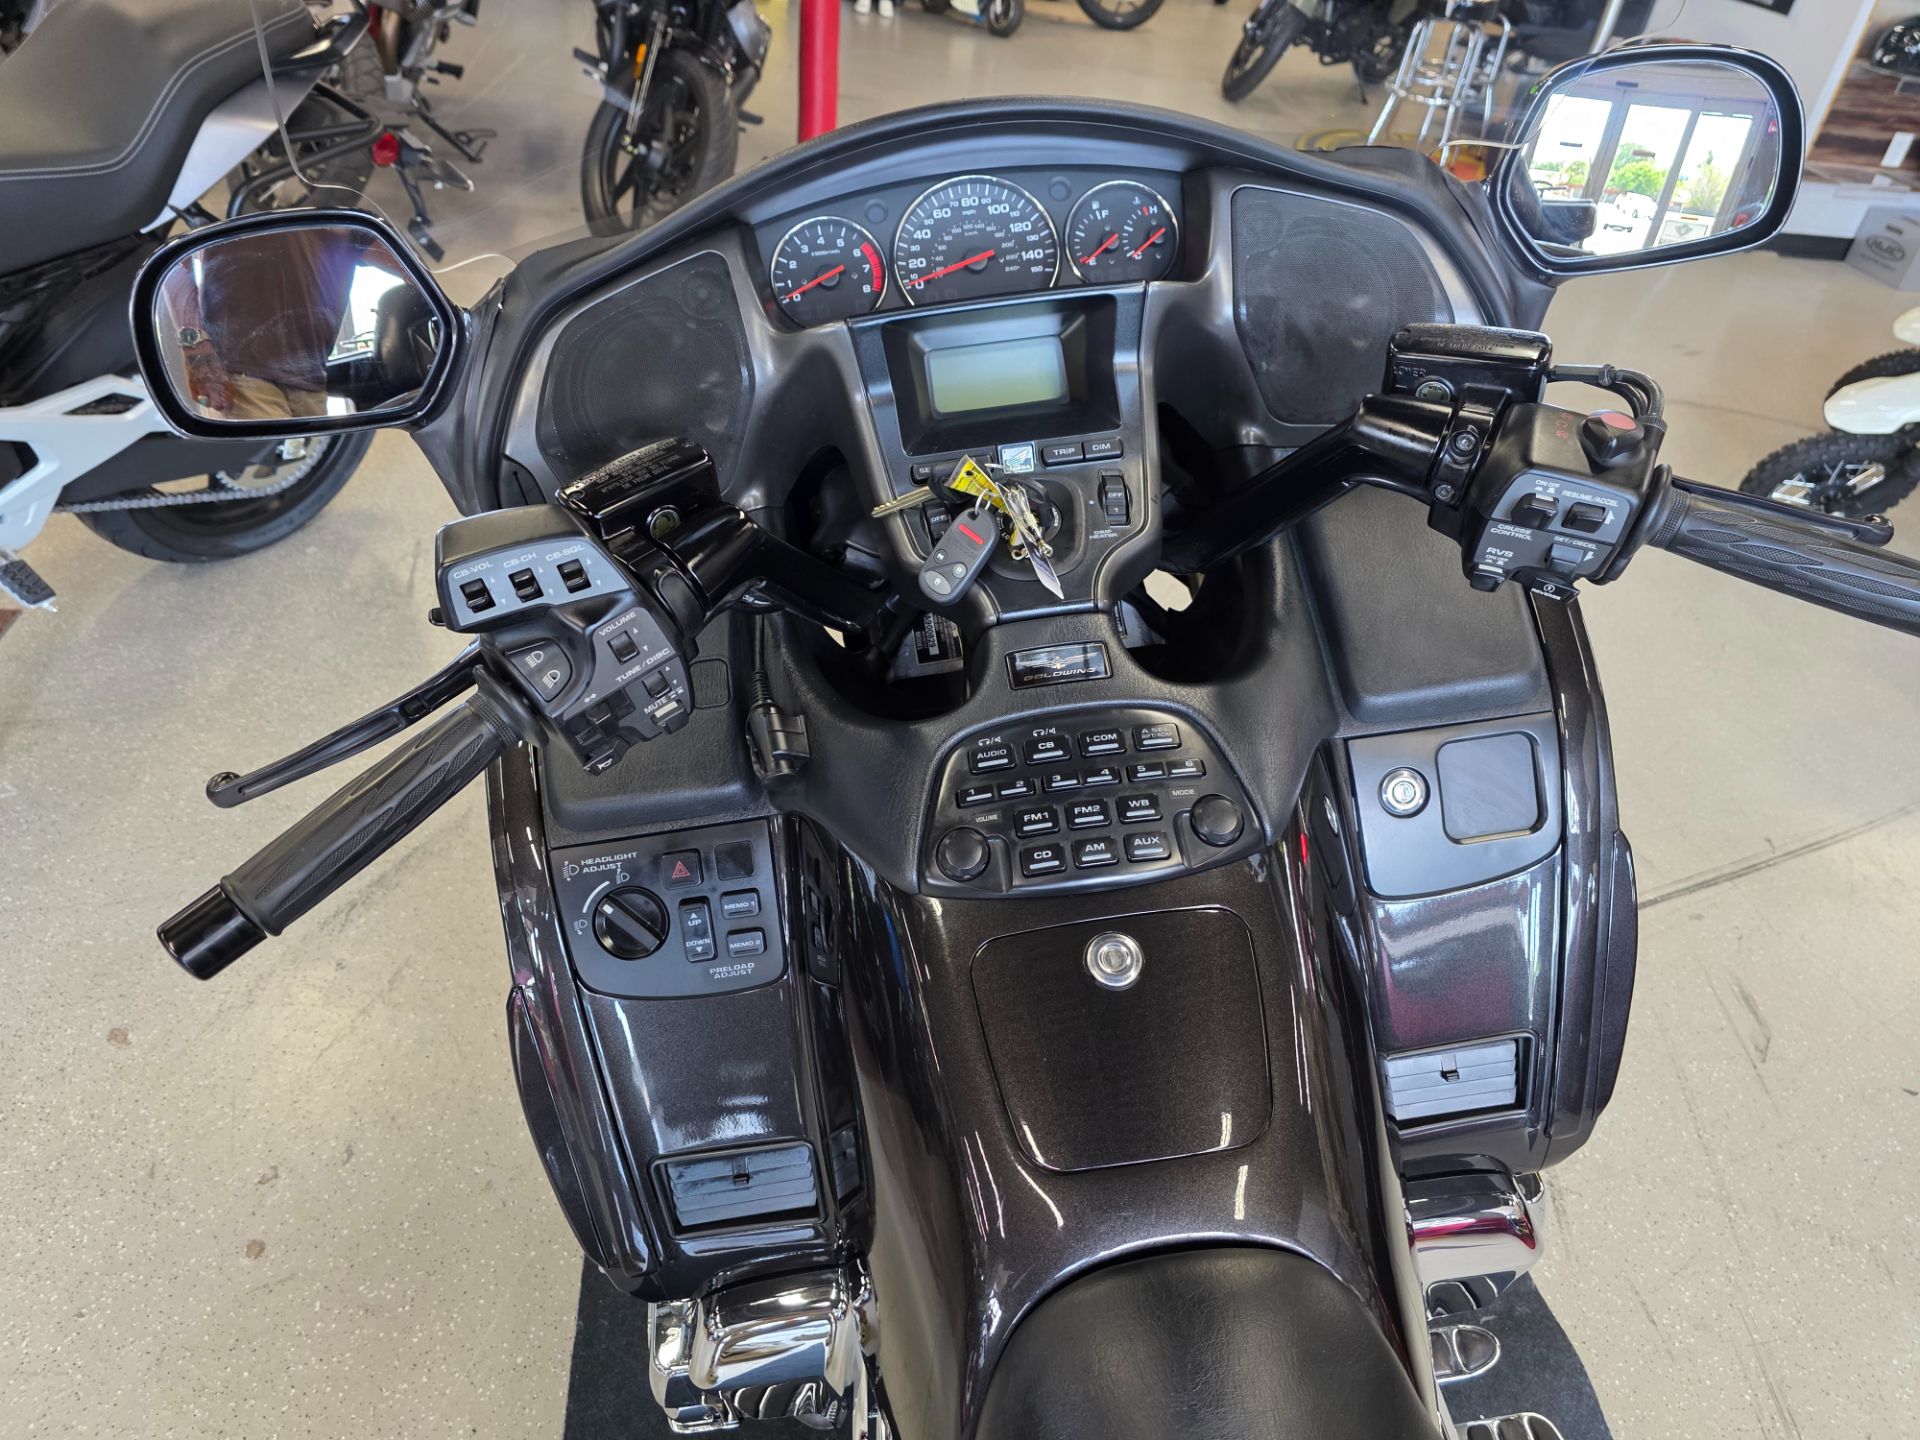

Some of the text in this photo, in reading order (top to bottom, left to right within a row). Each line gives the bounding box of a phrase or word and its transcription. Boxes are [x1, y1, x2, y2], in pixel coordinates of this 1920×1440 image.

[961, 196, 979, 207] 80
[981, 197, 991, 205] 90
[933, 208, 952, 219] 60
[987, 203, 1010, 215] 100
[1102, 210, 1109, 218] F
[1149, 205, 1158, 214] H
[1009, 221, 1032, 233] 120
[913, 229, 931, 239] 40
[1026, 234, 1039, 242] 130
[817, 236, 825, 245] 4
[836, 238, 845, 247] 5
[801, 245, 809, 253] 3
[853, 248, 861, 257] 6
[1021, 249, 1044, 261] 140
[789, 260, 798, 269] 2
[908, 258, 927, 268] 20
[1089, 257, 1097, 266] E
[862, 264, 870, 273] 7
[787, 280, 793, 288] 1
[862, 285, 871, 293] 8
[915, 279, 925, 289] 0
[793, 293, 801, 301] 0
[1052, 447, 1076, 456] TRIP
[1092, 442, 1111, 451] DIM
[1561, 490, 1619, 507] RESUME/ACCEL
[931, 514, 946, 523] OFF
[1497, 523, 1532, 534] CRUISE
[1089, 532, 1118, 540] HEATER
[1490, 528, 1532, 540] CONTROL
[1553, 536, 1598, 550] SET/DECEL
[545, 545, 585, 561] CB-SQL
[1486, 547, 1513, 557] RVS
[503, 552, 537, 568] CB-CH
[453, 561, 495, 579] CB-VOL
[1531, 588, 1561, 600] REVERSE
[599, 611, 637, 636] VOLUME
[1023, 667, 1097, 681] GOLDWING
[643, 696, 668, 714] MUTE
[1086, 733, 1118, 742] I-COM
[1038, 741, 1055, 749] CB
[977, 749, 1007, 760] AUDIO
[1172, 788, 1196, 797] MODE
[1128, 799, 1150, 807] WB
[1074, 805, 1101, 815] FM2
[975, 813, 999, 823] VOLUME
[1023, 812, 1050, 822] FM1
[1134, 836, 1161, 846] AUX
[1085, 842, 1105, 852] AM
[581, 852, 639, 865] HEADLIGHT
[1033, 851, 1052, 859] CD
[582, 862, 622, 873] ADJUST
[724, 902, 749, 910] MEMO
[685, 938, 710, 947] DOWN
[729, 940, 754, 949] MEMO
[709, 962, 755, 975] PRELOAD
[714, 968, 753, 979] ADJUST
